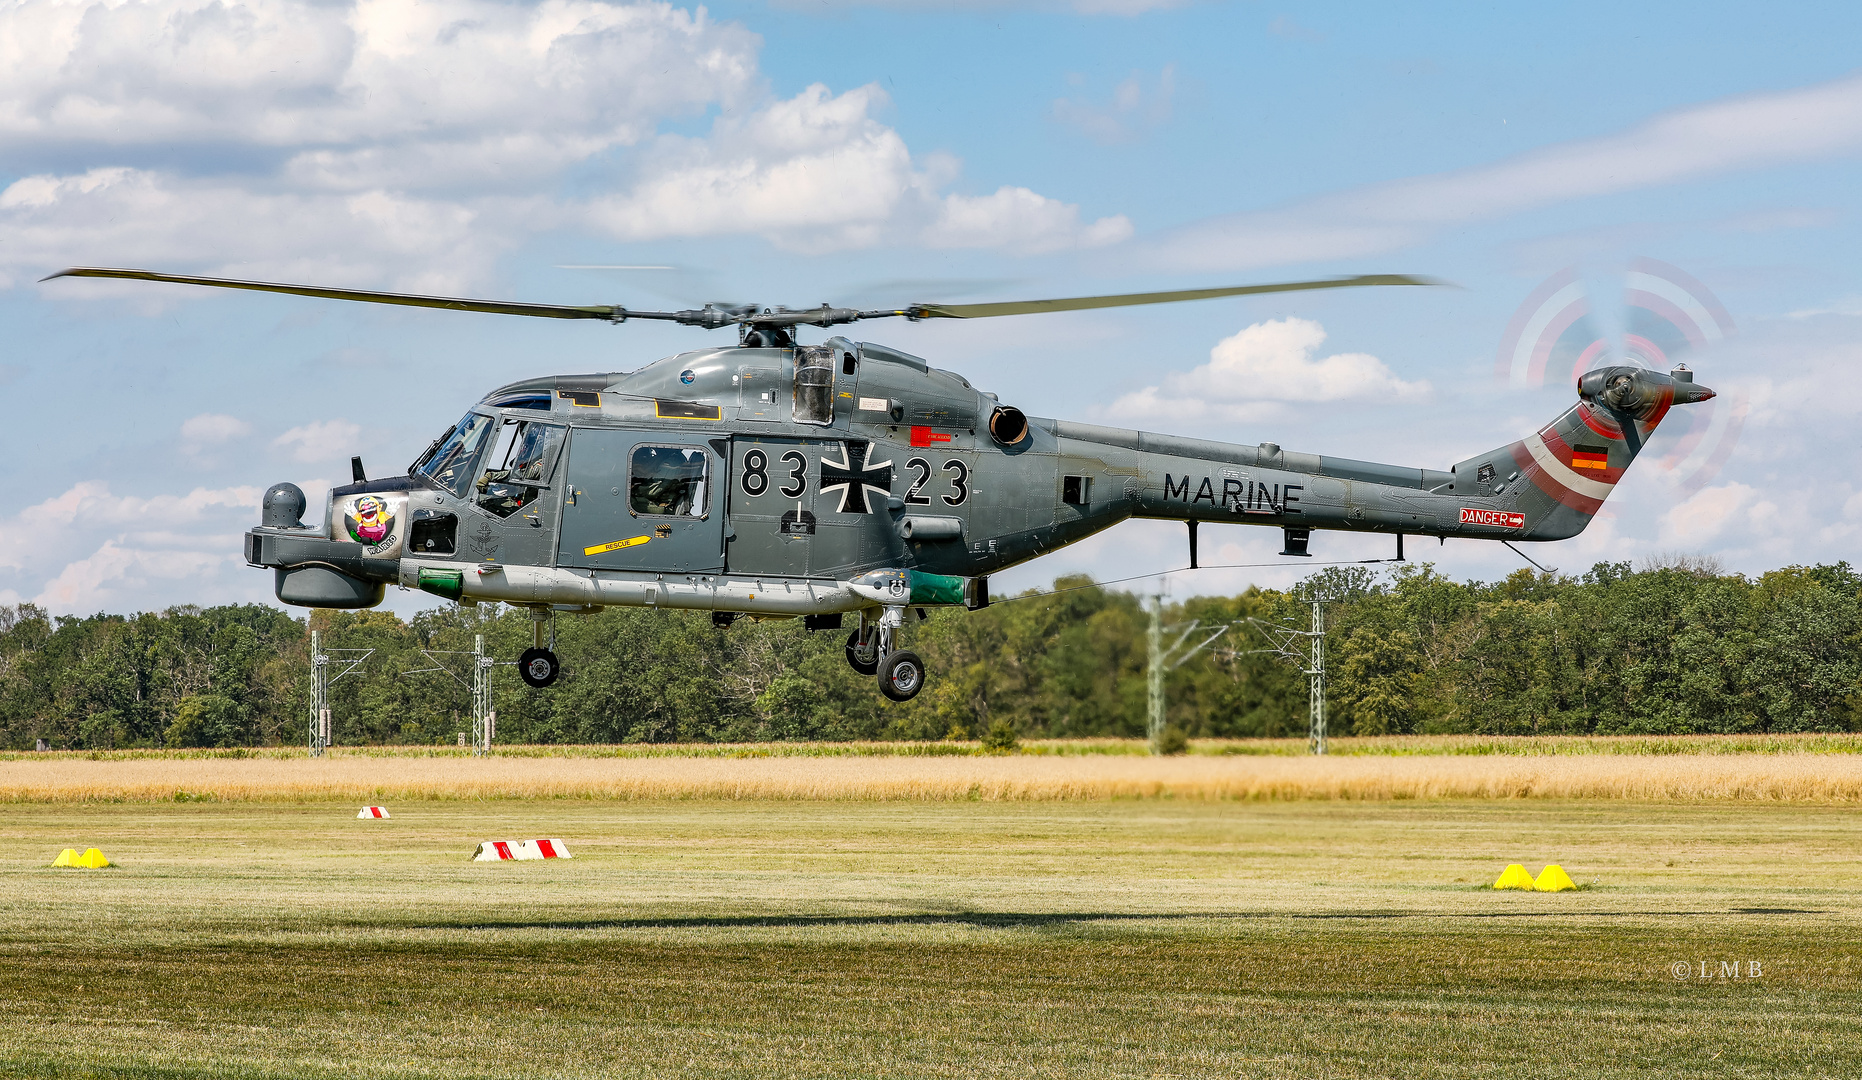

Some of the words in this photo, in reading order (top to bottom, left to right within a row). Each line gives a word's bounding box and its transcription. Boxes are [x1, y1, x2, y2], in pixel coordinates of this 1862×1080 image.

[741, 449, 808, 498] 83
[904, 457, 968, 506] 23
[1163, 473, 1304, 513] MARINE
[1460, 510, 1508, 526] DANGER
[605, 540, 631, 550] RESCUE
